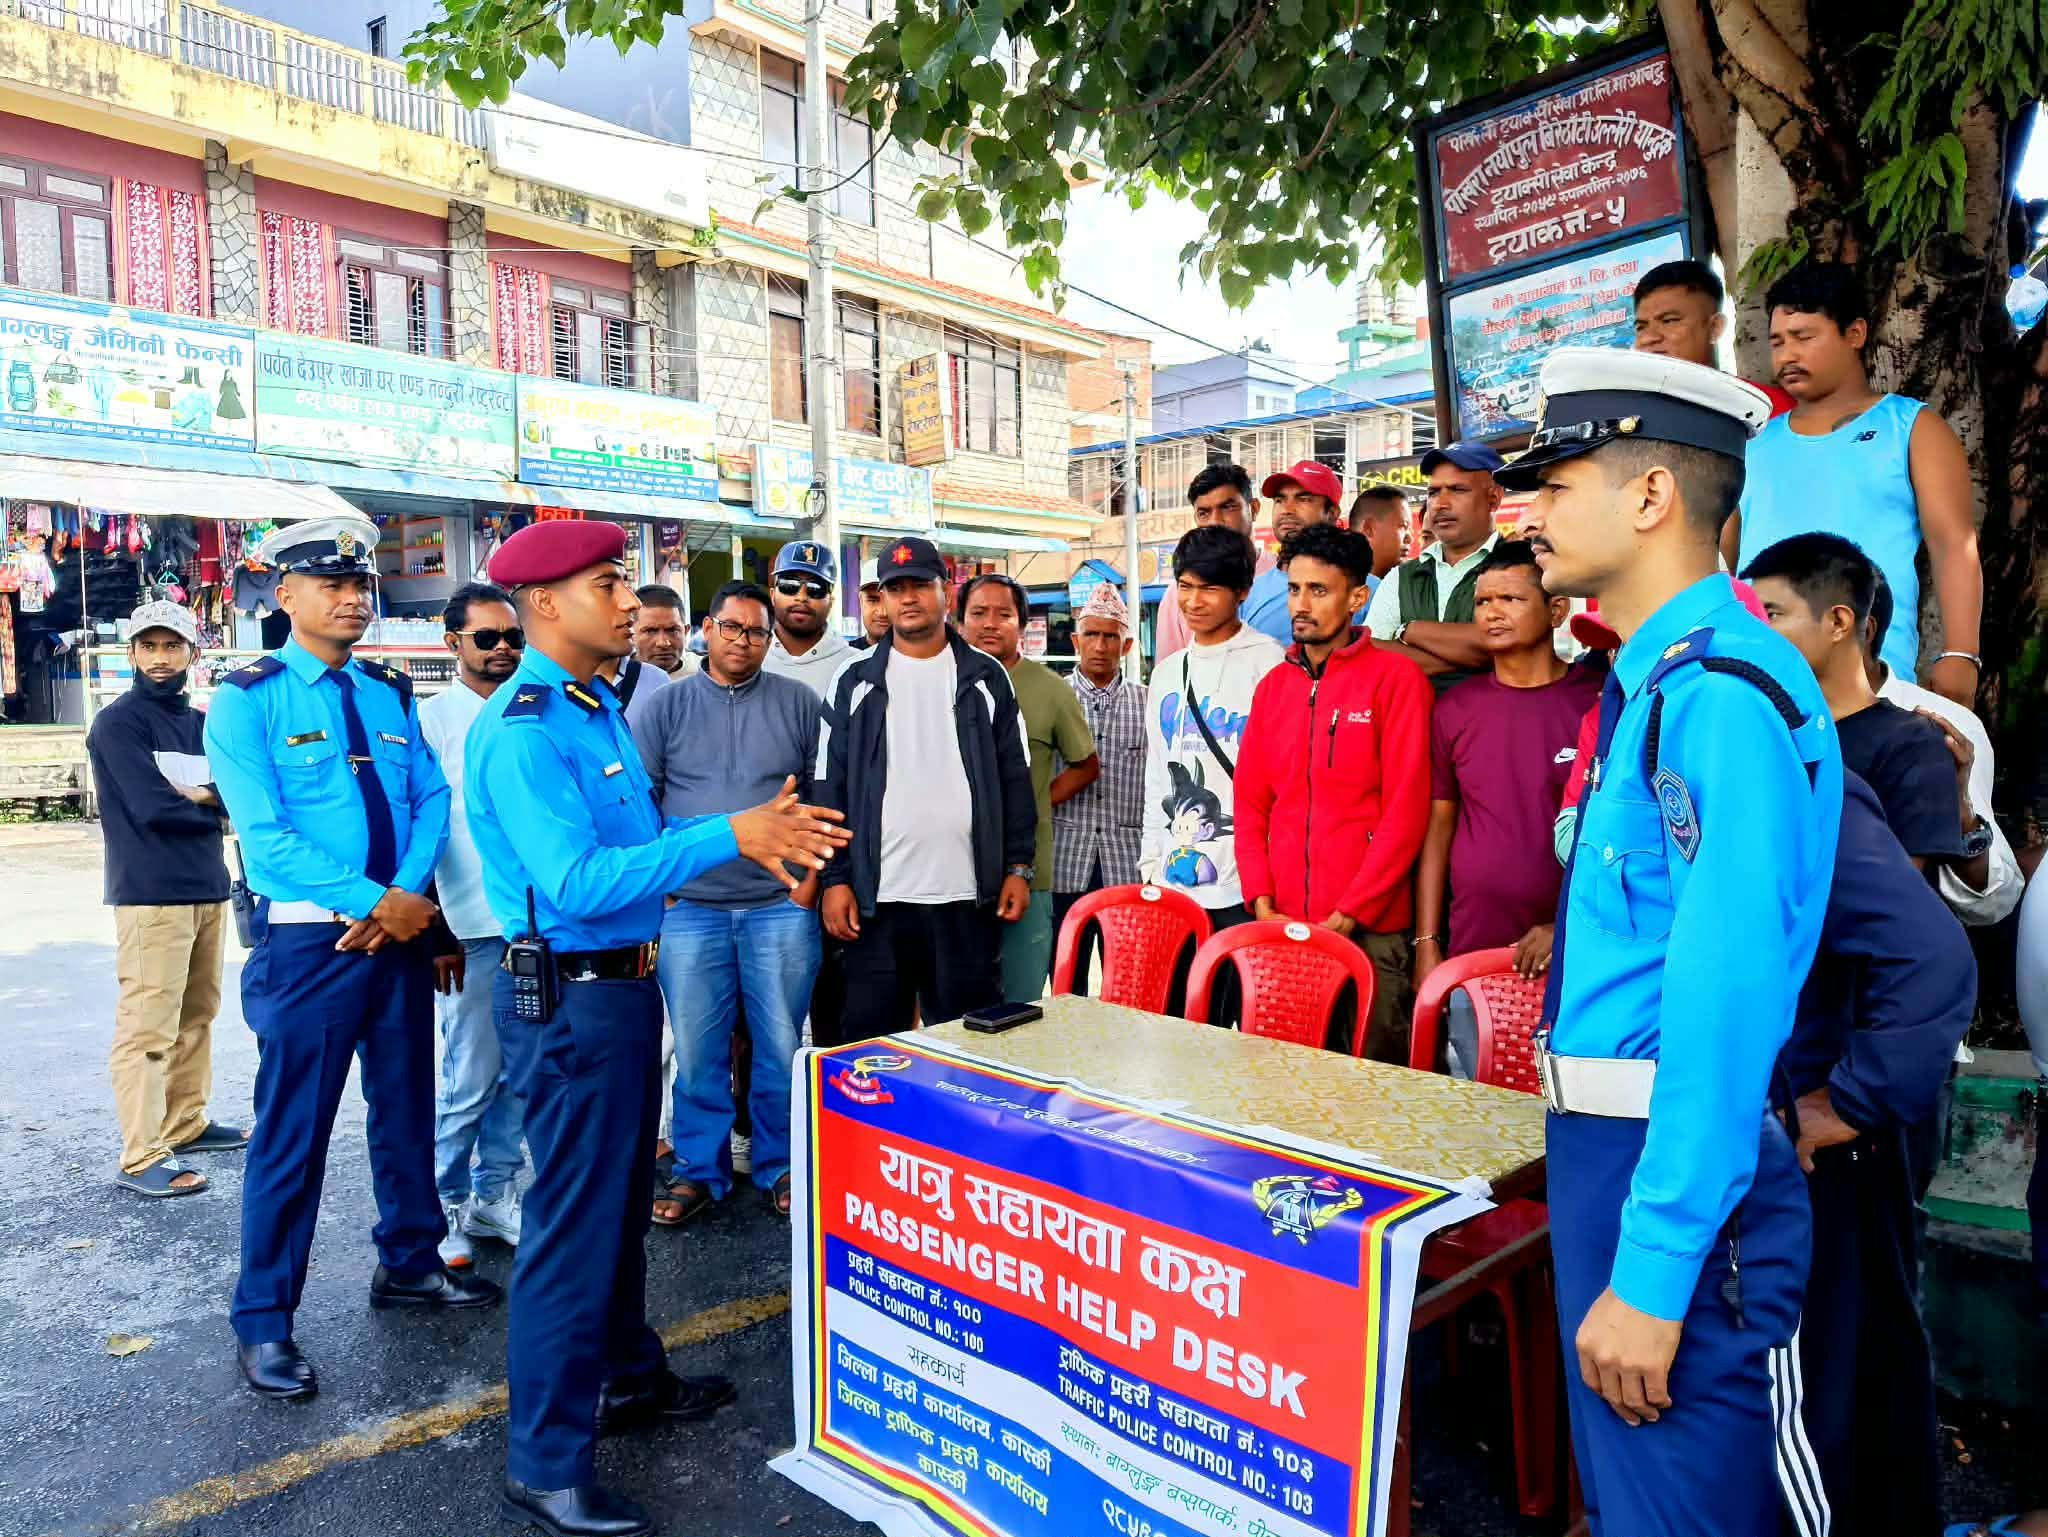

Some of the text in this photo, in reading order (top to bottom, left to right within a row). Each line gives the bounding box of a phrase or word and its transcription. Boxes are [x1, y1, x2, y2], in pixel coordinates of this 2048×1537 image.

[1388, 464, 1431, 485] CRI
[879, 1143, 1246, 1319] यात्रु सहायता कक्ष
[845, 1191, 1308, 1419] PASSENGER HELP DESK
[847, 1250, 875, 1278] प्रहरी
[877, 1265, 926, 1301] सहायता
[953, 1299, 983, 1325] १००
[848, 1275, 882, 1307] POLICE
[883, 1293, 933, 1331] CONTROL
[962, 1330, 984, 1354] 100
[836, 1342, 1052, 1477] जिल्ला प्रहरी कार्यालय, कास्की
[905, 1343, 967, 1388] सहकार्य
[1058, 1344, 1107, 1387] ट्राफिक
[1110, 1372, 1152, 1410] प्रहरी
[1156, 1394, 1231, 1444] सहायता
[836, 1378, 1049, 1516] जिल्ला ट्राफिक प्रहरी कार्यालय
[916, 1452, 968, 1495] कास्की
[1057, 1374, 1106, 1419] TRAFFIC
[1108, 1403, 1159, 1447] POLICE
[1162, 1430, 1238, 1482] CONTROL
[1282, 1486, 1314, 1516] 103
